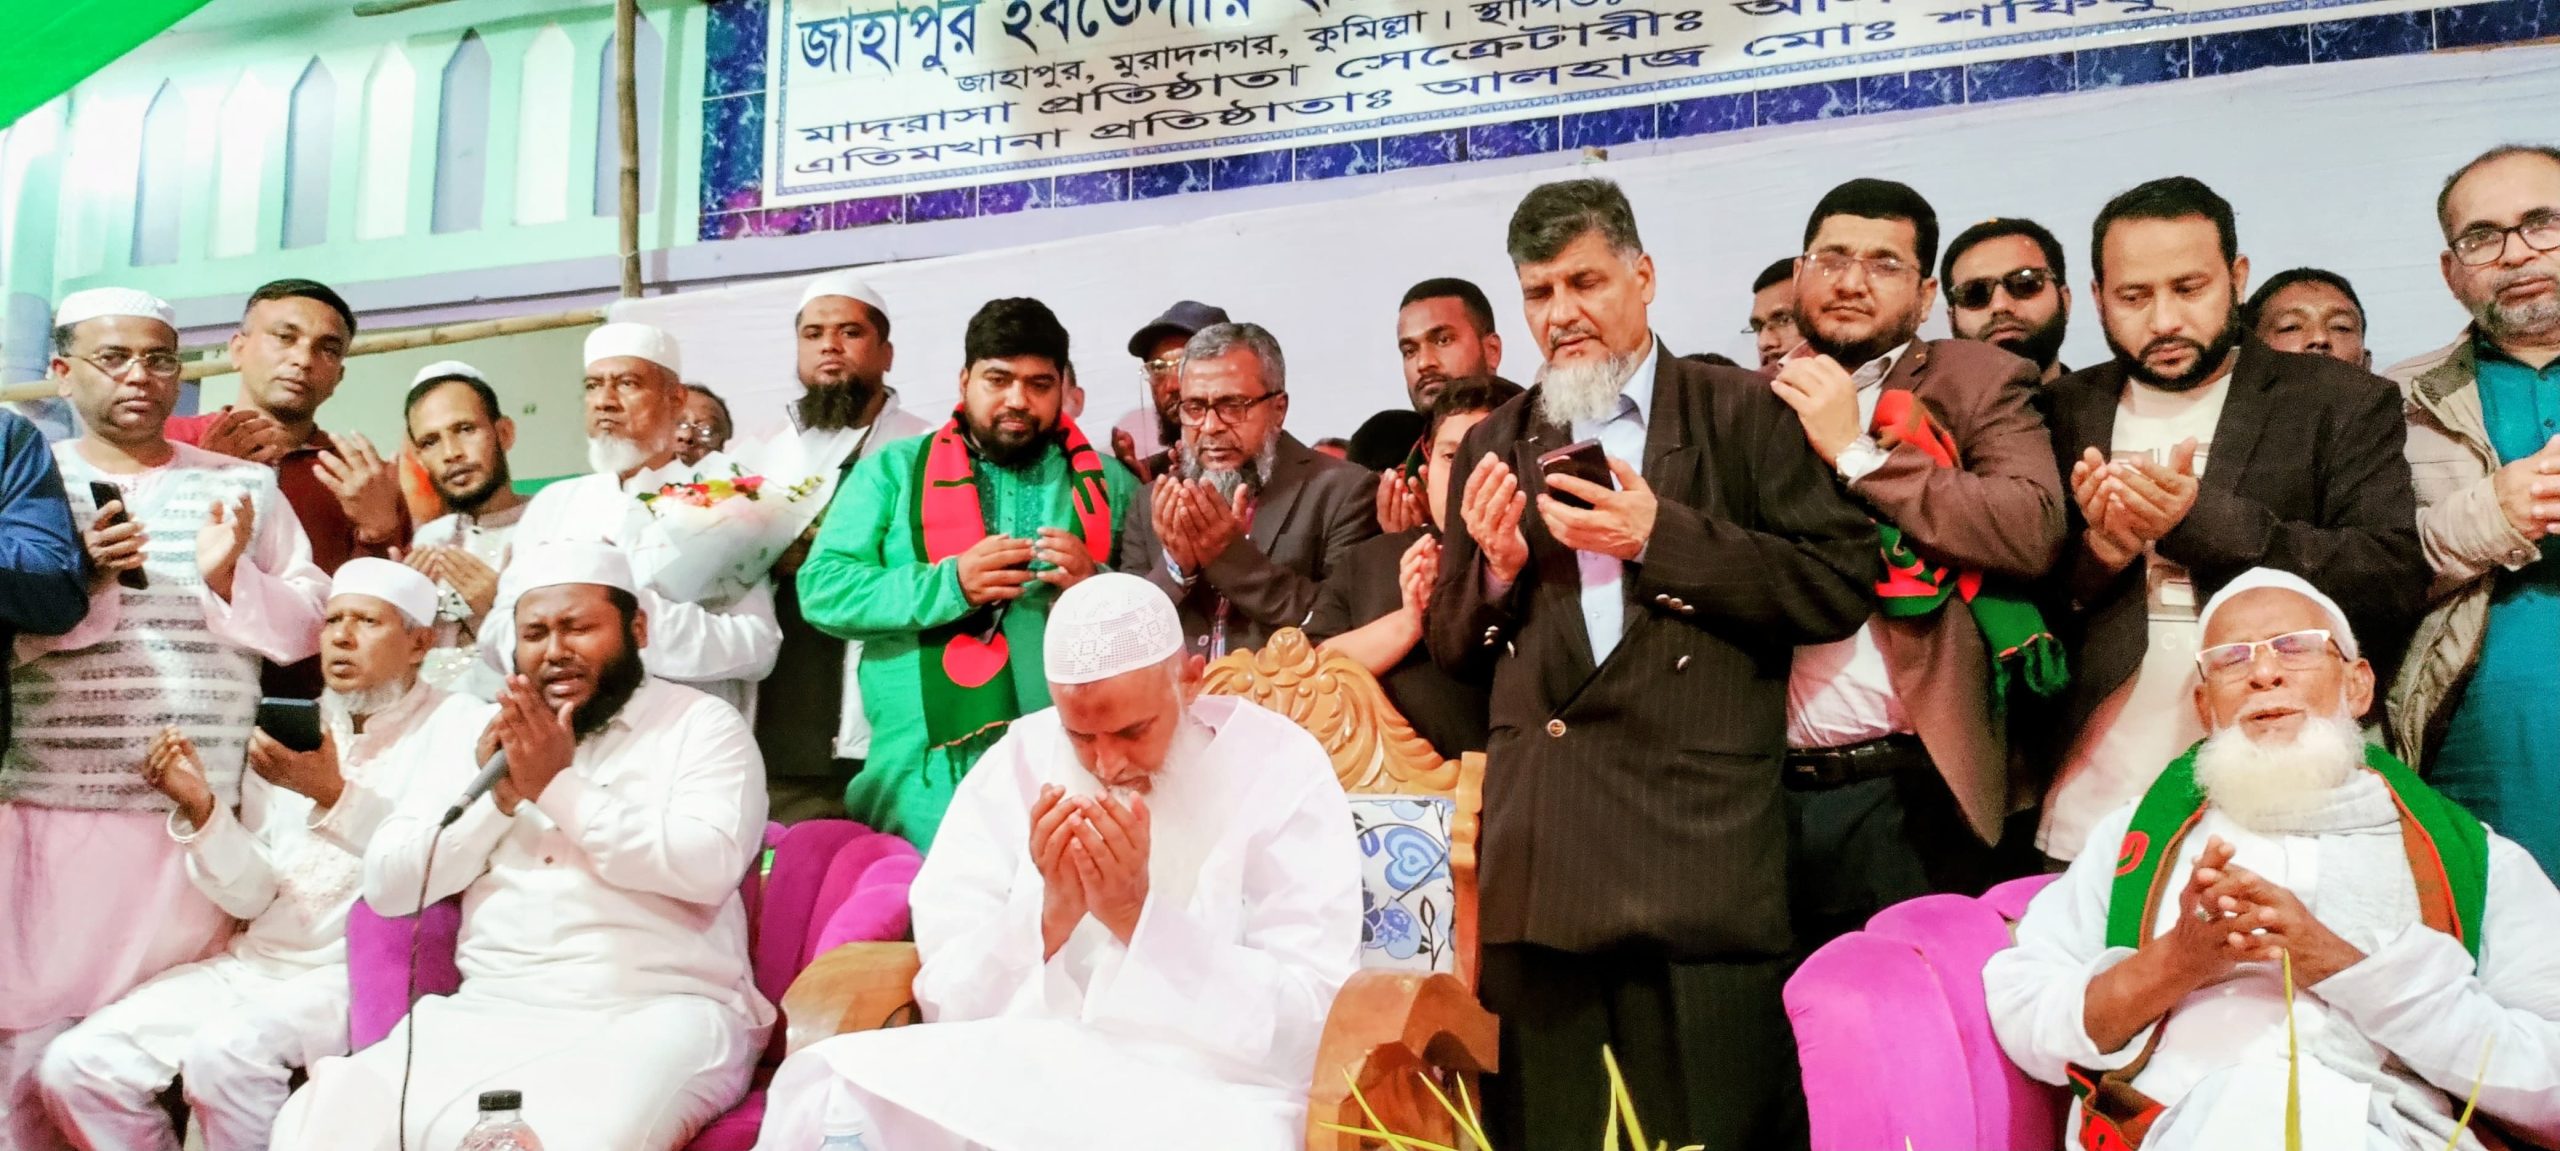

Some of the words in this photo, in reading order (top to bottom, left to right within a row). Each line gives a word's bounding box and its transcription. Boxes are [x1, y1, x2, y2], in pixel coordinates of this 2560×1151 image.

[796, 0, 986, 76] জাহাপুর
[955, 60, 1095, 95] জাহাপুর,
[1110, 34, 1289, 80] মুরাদনগর,
[1303, 10, 1428, 53] কুমিল্লা
[1038, 63, 1312, 115] প্রতিষ্ঠাতা
[795, 127, 1070, 174] এতিমখানা
